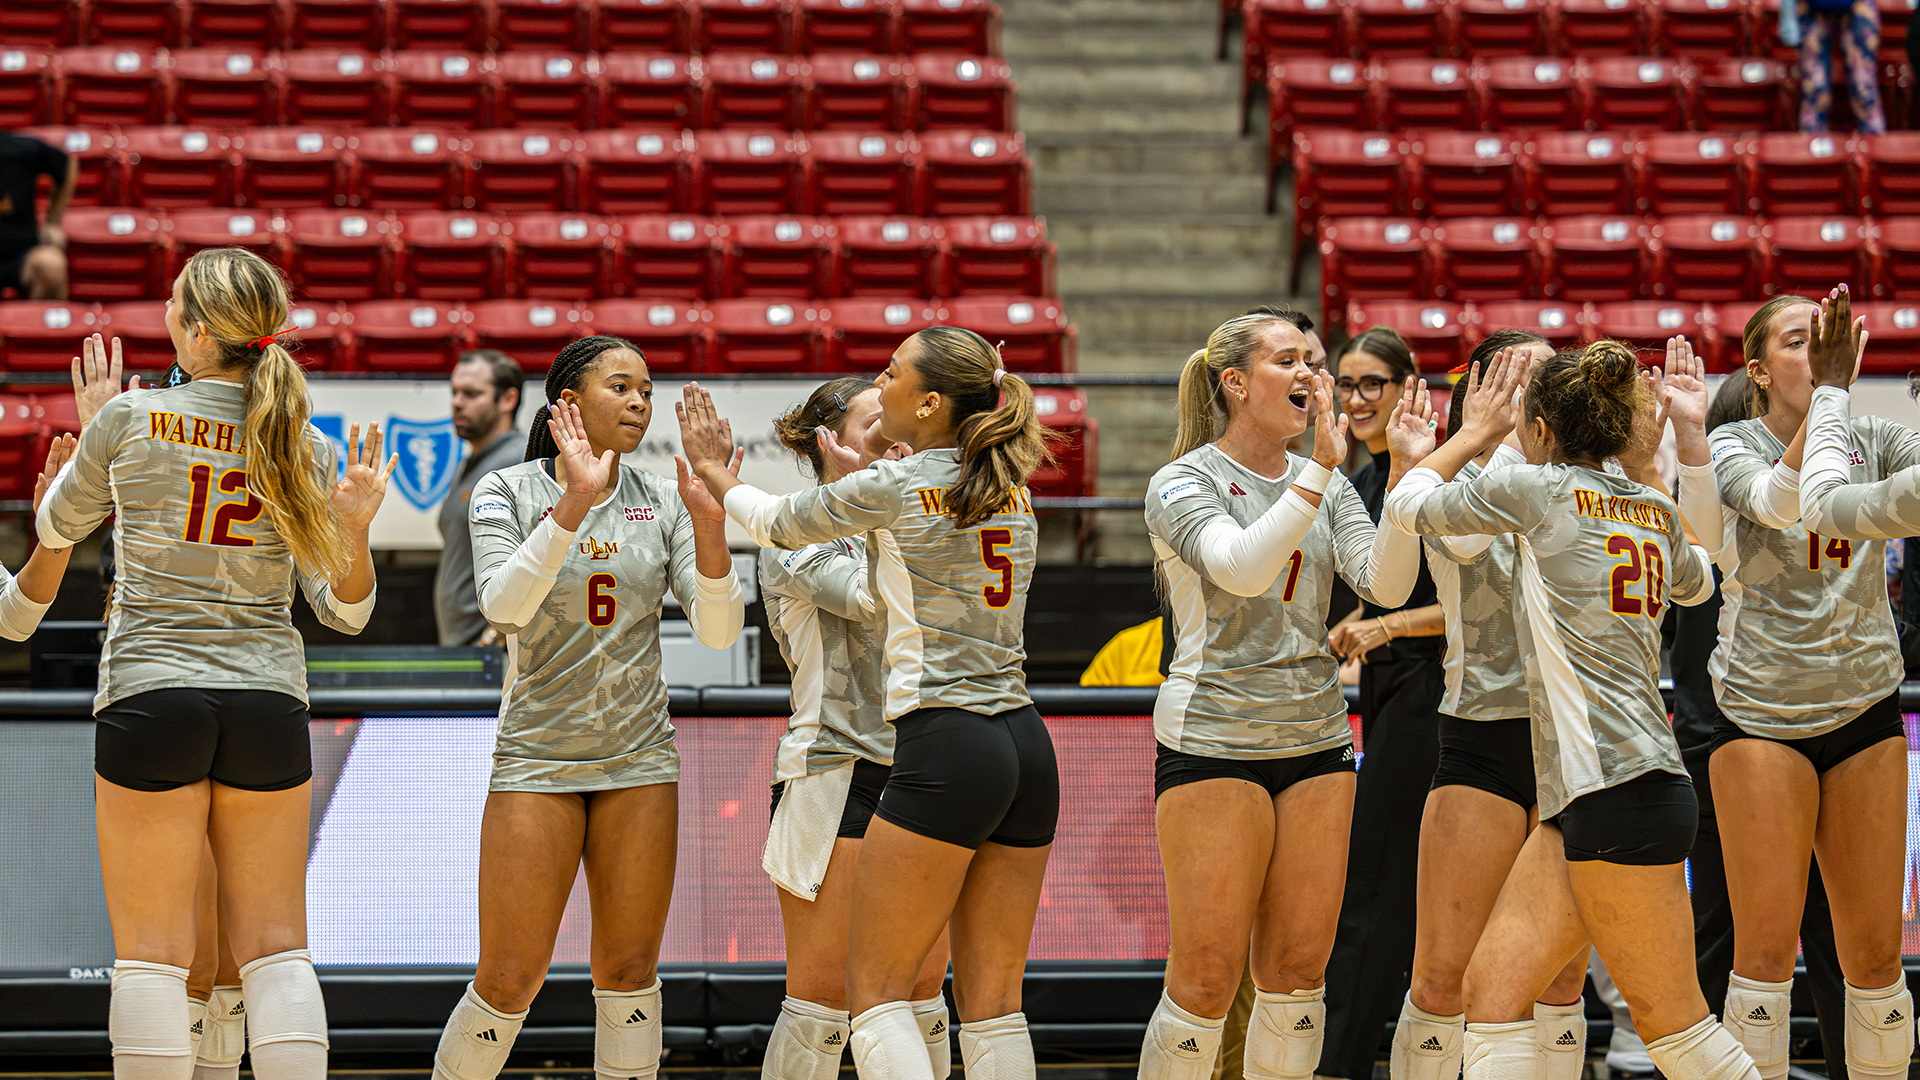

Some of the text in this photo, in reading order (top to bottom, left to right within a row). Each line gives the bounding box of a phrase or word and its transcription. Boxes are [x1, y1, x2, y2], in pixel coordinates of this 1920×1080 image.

[182, 462, 265, 547] 12
[1572, 488, 1672, 536] WARHAWKS
[579, 535, 619, 561] ULM
[1805, 528, 1853, 572] 14
[979, 527, 1015, 611] 5
[1604, 532, 1665, 621] 20
[586, 572, 618, 628] 6
[1293, 1023, 1315, 1031] adidas
[1747, 1013, 1771, 1021] adidas
[1884, 1014, 1904, 1025] adidas
[1177, 1043, 1200, 1053] adidas
[1419, 1042, 1443, 1051] adidas
[1555, 1037, 1577, 1046] adidas
